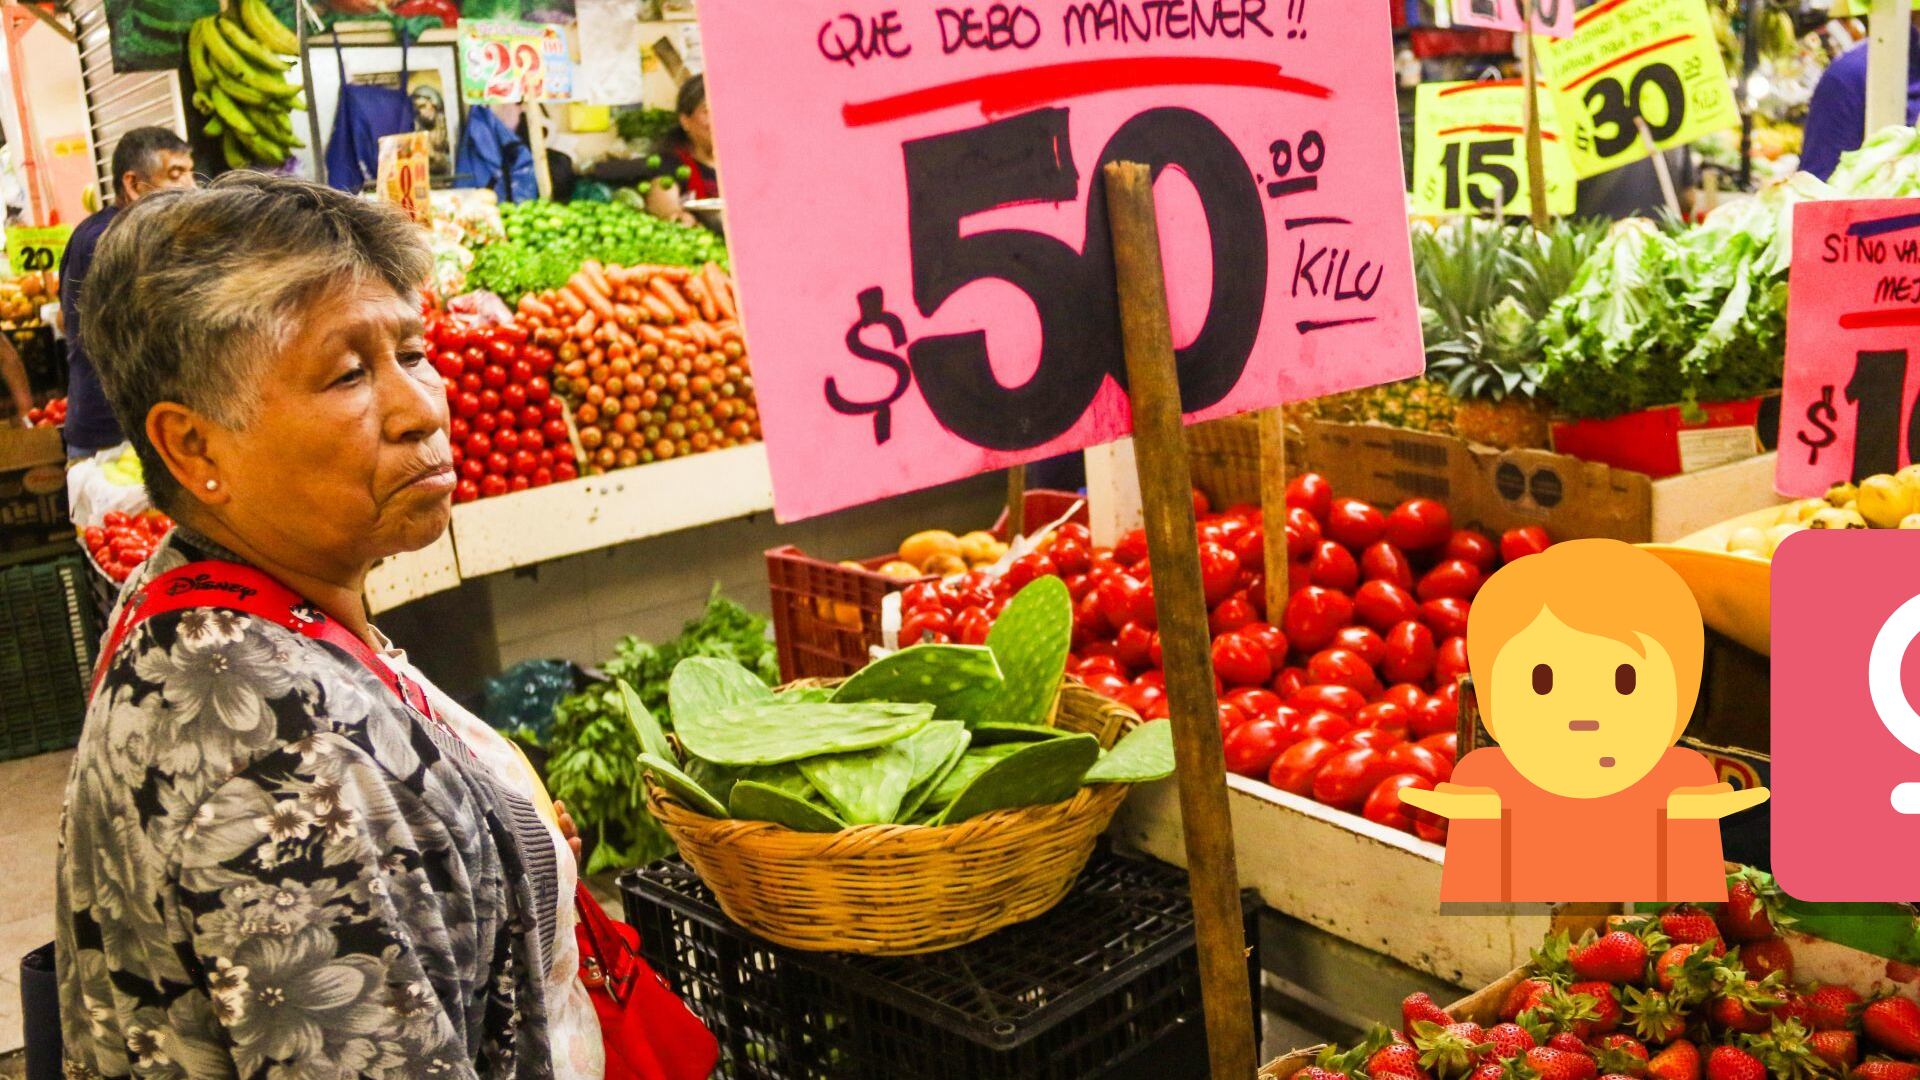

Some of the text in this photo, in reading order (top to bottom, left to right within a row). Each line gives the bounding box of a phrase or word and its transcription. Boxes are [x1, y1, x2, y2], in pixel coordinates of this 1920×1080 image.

[818, 10, 912, 67] QUE
[936, 4, 1041, 54] DEBO
[1063, 0, 1274, 46] MANTENER
[1856, 236, 1887, 264] NO
[1893, 239, 1920, 264] VA
[1797, 348, 1920, 488] $1
